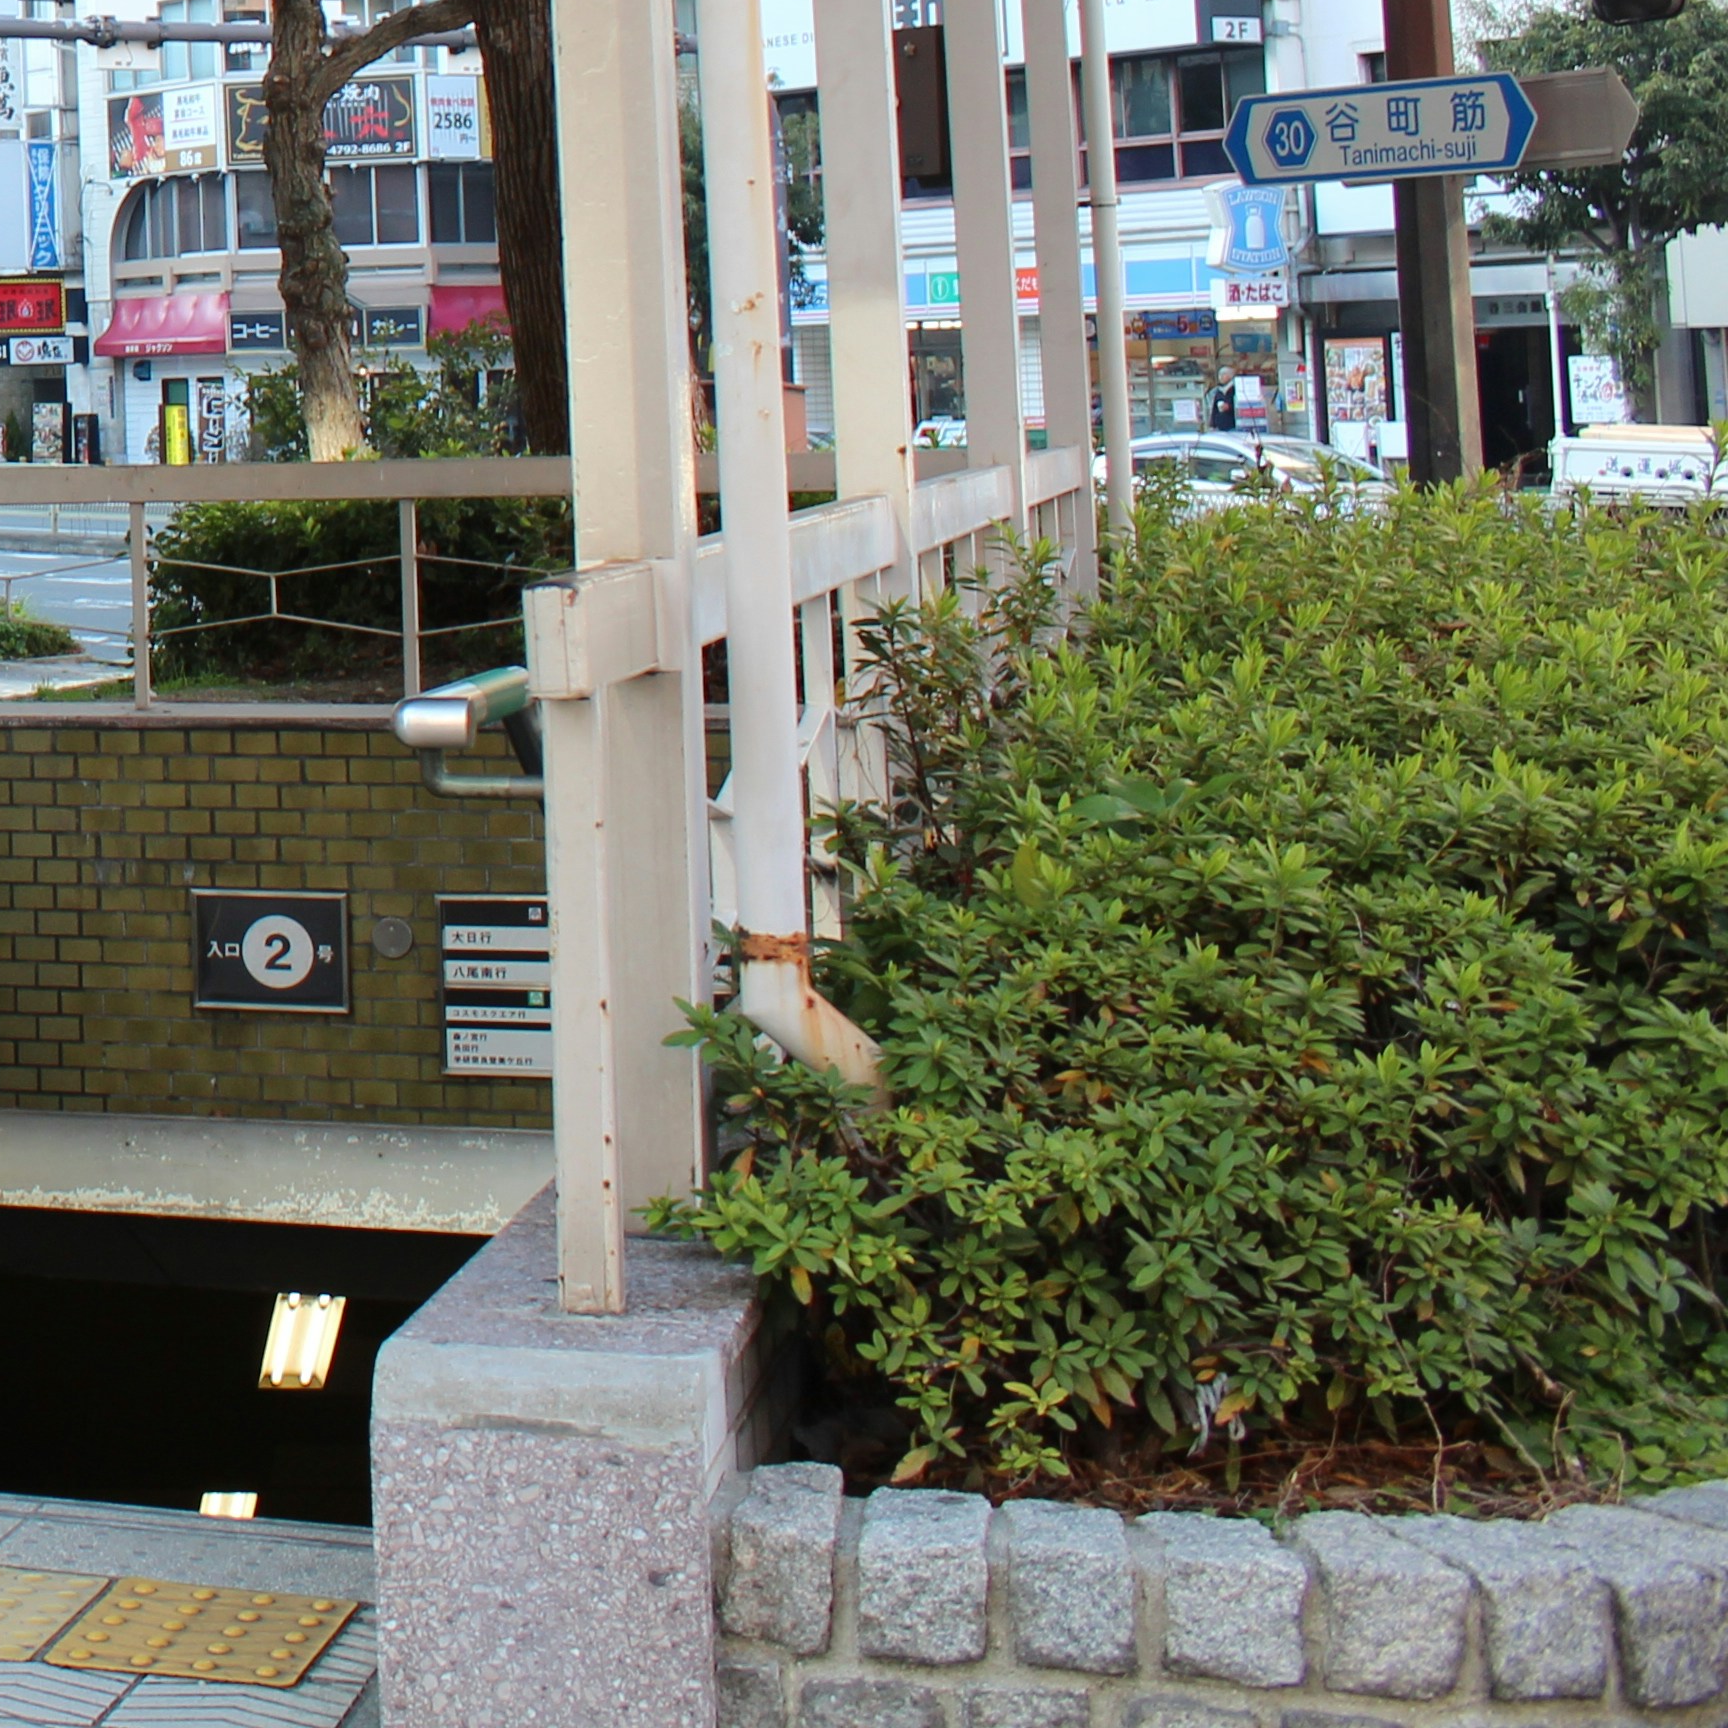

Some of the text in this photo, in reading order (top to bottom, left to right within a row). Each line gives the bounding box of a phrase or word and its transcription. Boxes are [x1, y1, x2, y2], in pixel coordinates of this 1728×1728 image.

[1224, 21, 1250, 40] 2F
[434, 113, 473, 130] 2586
[1325, 90, 1486, 144] 谷町筋
[395, 141, 411, 153] 2F
[1275, 120, 1305, 157] 30
[1340, 137, 1477, 166] Tanimachi-suji
[1227, 188, 1279, 206] LAWSON
[231, 322, 280, 339] コーヒー
[451, 930, 492, 944] 大日行
[207, 940, 240, 959] 入口
[265, 932, 292, 970] 2
[317, 944, 334, 963] 号
[453, 966, 507, 980] 八尾南行
[453, 1009, 526, 1019] コスモスクエア行
